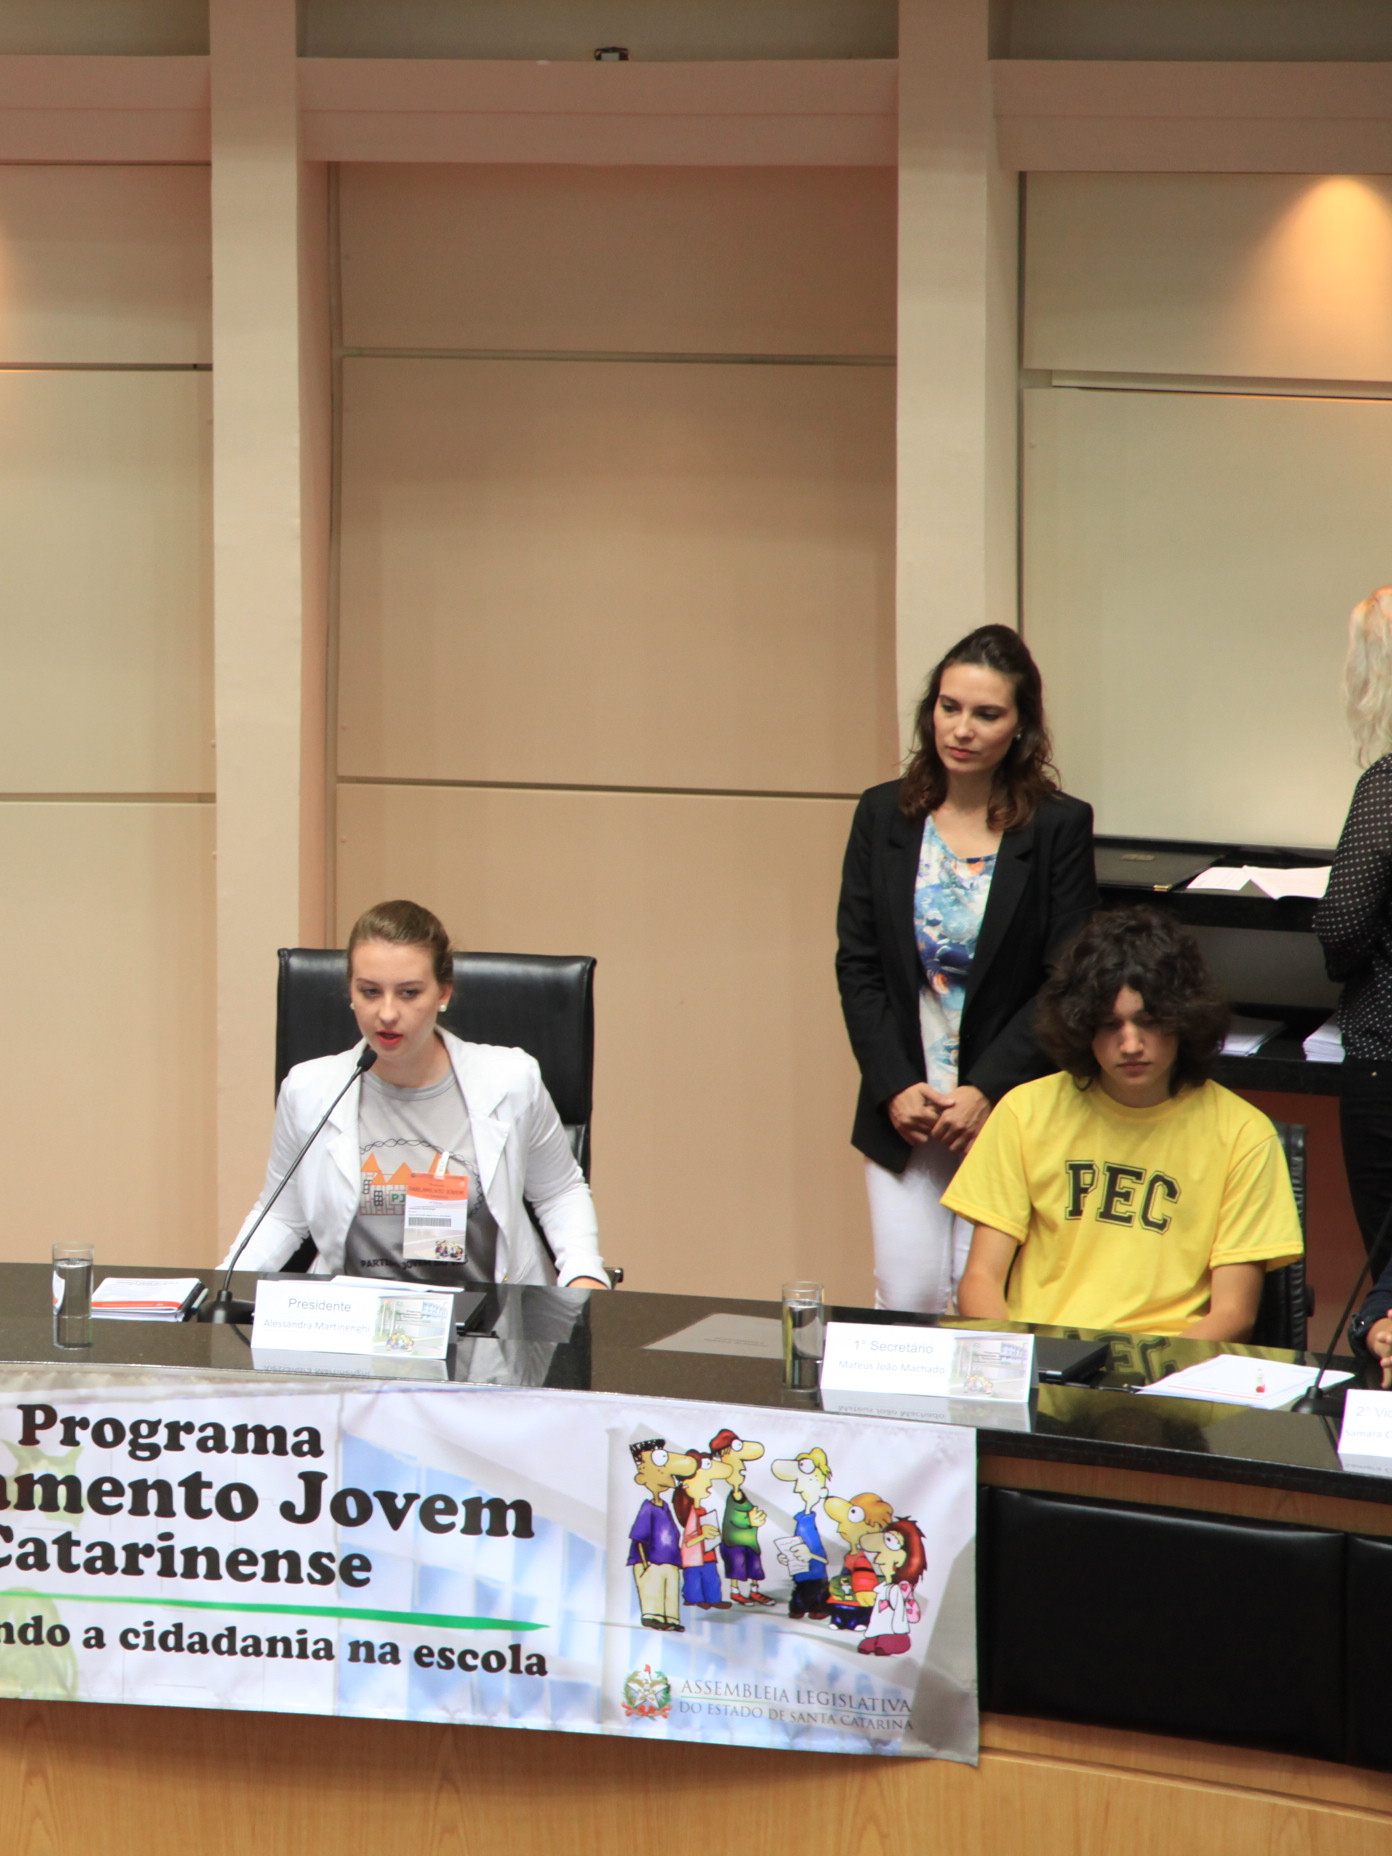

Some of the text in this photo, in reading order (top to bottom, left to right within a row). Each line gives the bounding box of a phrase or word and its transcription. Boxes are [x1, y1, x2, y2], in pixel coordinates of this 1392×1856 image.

[1064, 1159, 1182, 1235] PEC
[287, 1297, 352, 1313] Presidente
[263, 1319, 370, 1334] Alessandra Martinenghi
[869, 1340, 934, 1354] Secretário
[838, 1360, 945, 1375] Mateus João Machado
[16, 1403, 324, 1462] Programa
[279, 1471, 535, 1539] Jovem
[82, 1626, 106, 1649] a
[119, 1622, 335, 1661] cidadania
[348, 1640, 401, 1665] na
[413, 1643, 548, 1677] escola
[680, 1679, 913, 1713] ASSEMBLEIA LEGISLATIVA
[678, 1701, 915, 1731] DO ESTADO DE SANTA CATARINA
